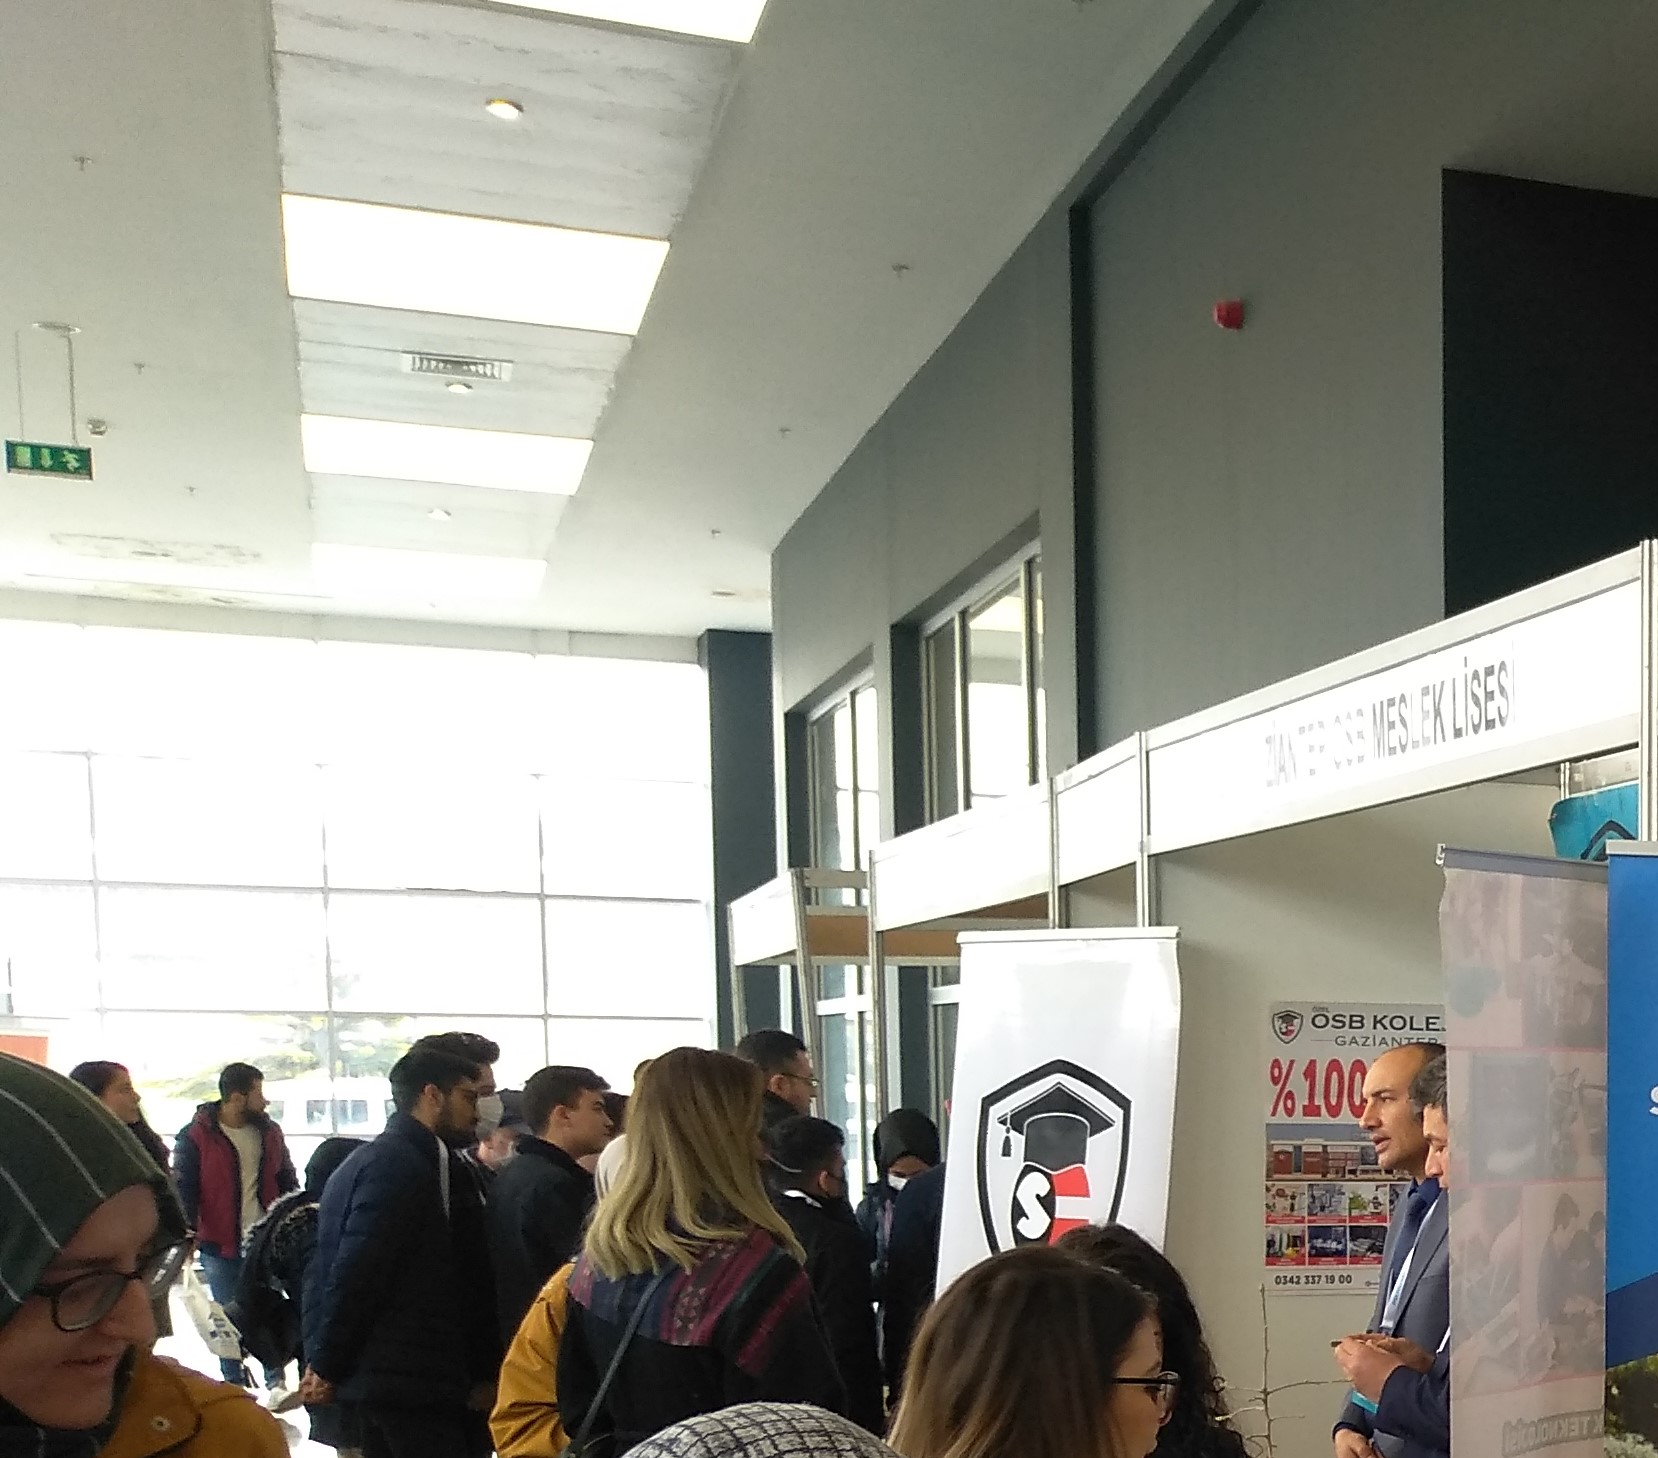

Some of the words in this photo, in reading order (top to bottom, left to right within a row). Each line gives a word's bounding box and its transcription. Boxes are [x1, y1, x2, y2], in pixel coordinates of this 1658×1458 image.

[1372, 680, 1447, 760] MESLEK
[1311, 1014, 1365, 1030] OSB
[1373, 1015, 1446, 1031] KOLE
[1269, 1058, 1368, 1119] %100
[1275, 1275, 1301, 1285] 0342
[1304, 1275, 1322, 1285] 337
[1325, 1275, 1336, 1284] 19
[1338, 1275, 1353, 1284] 00
